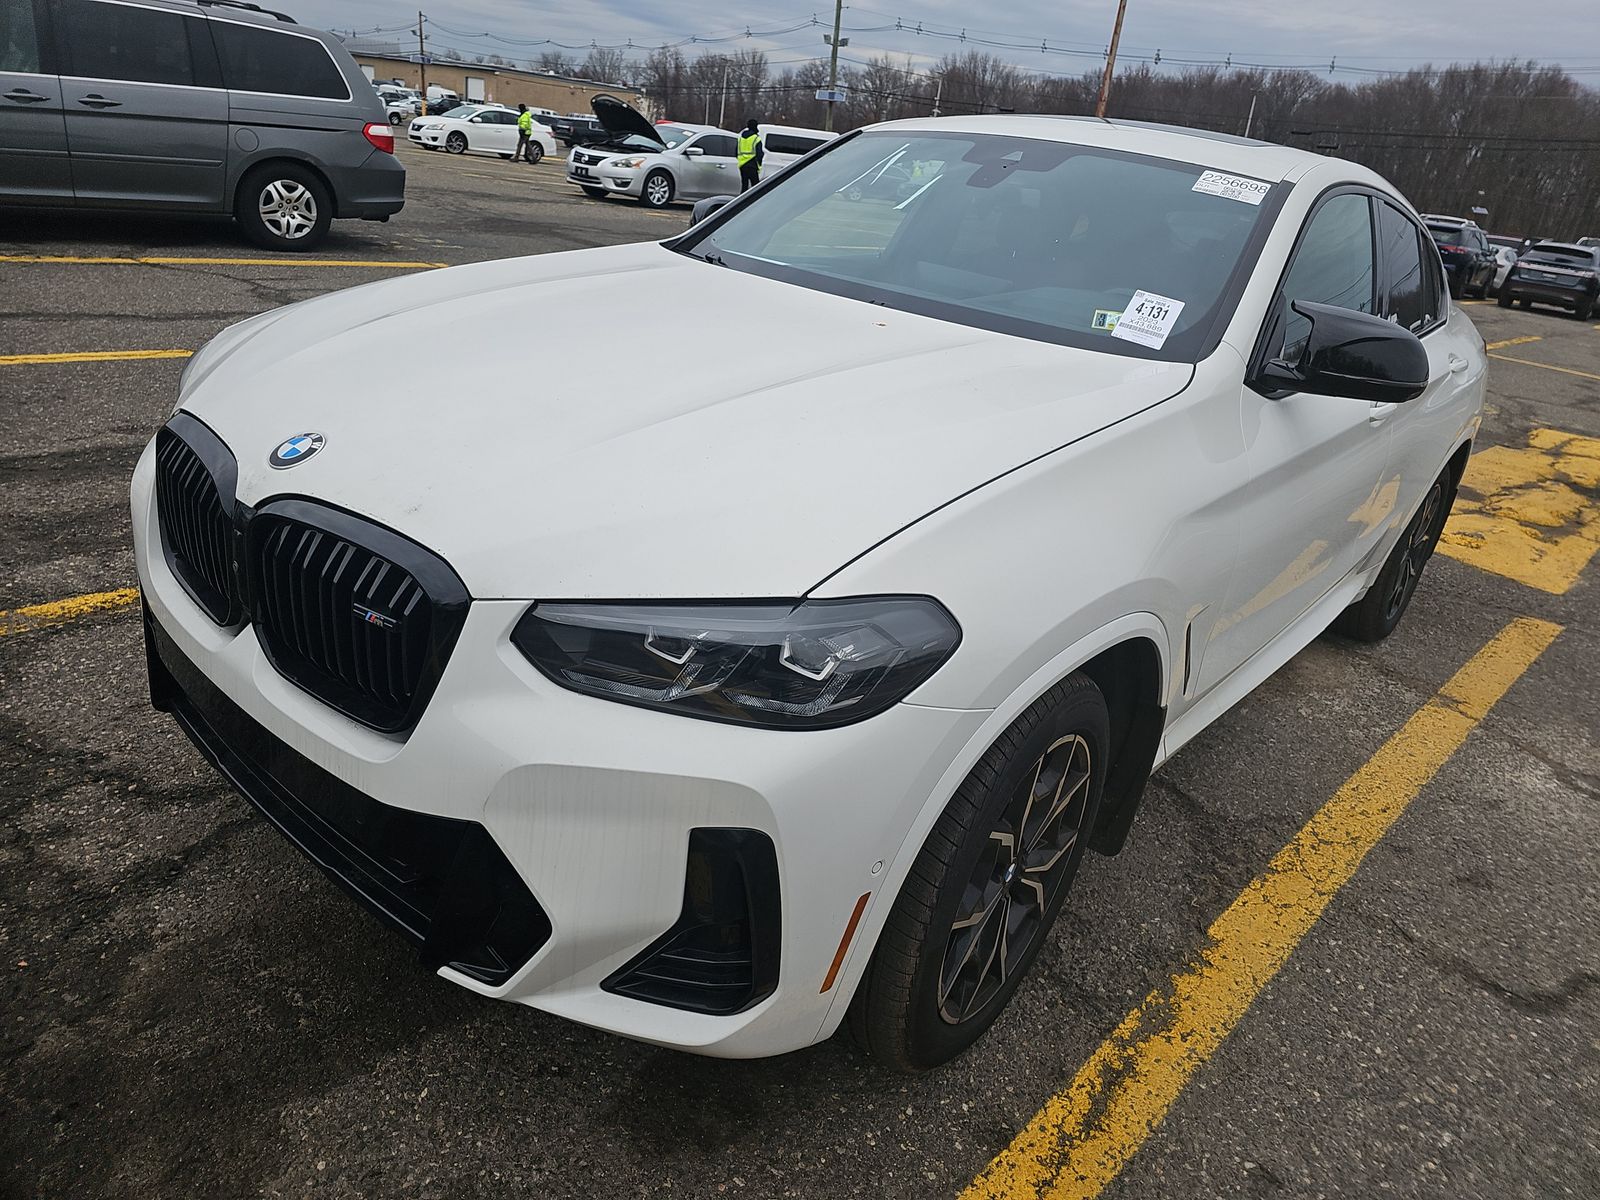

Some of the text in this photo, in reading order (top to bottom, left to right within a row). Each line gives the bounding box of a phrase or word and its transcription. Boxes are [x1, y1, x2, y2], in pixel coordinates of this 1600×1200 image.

[1202, 173, 1268, 194] 2256698
[1135, 302, 1170, 321] 4:131
[1137, 316, 1159, 325] 2023
